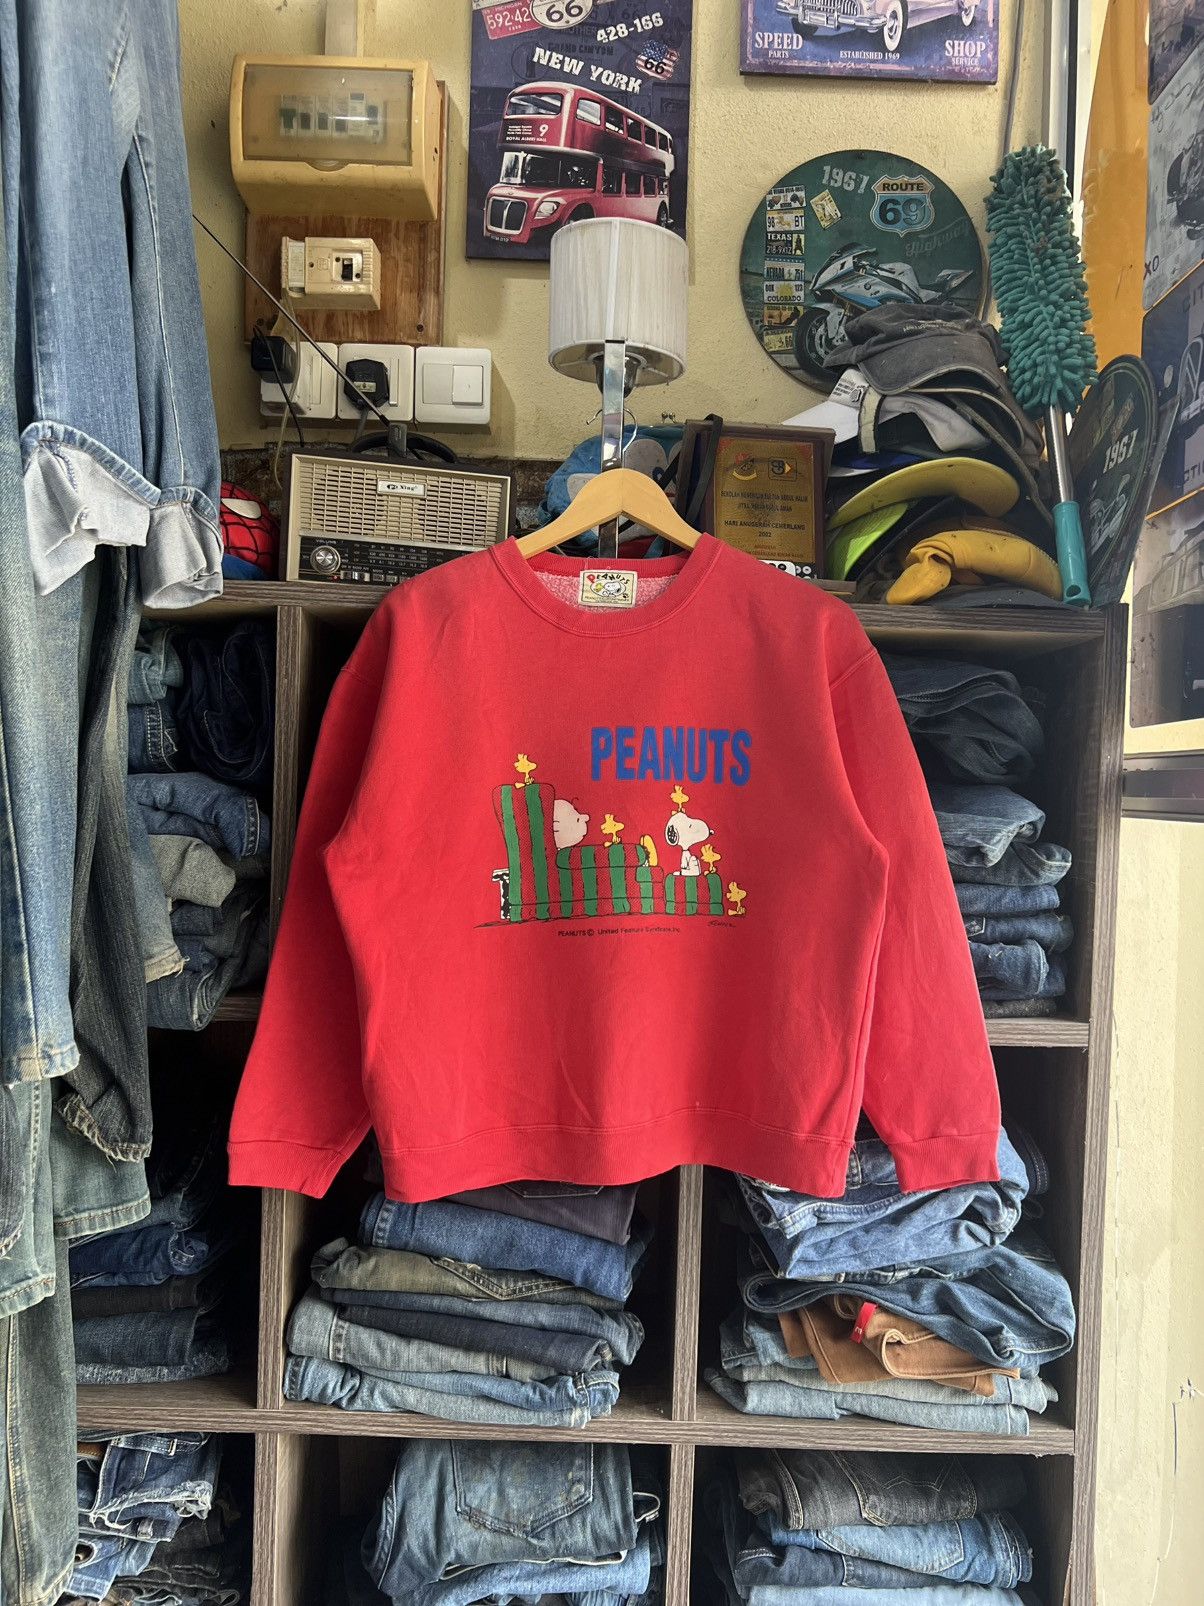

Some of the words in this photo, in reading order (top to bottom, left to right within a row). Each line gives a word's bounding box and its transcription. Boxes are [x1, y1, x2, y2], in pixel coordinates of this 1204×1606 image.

[545, 0, 584, 23] 66
[596, 12, 664, 43] 428-166
[754, 31, 804, 50] SPEED
[945, 39, 986, 57] SHOP
[768, 50, 790, 59] PARTS
[839, 50, 883, 60] ESTABLISHED
[884, 52, 901, 60] 1969
[951, 57, 980, 66] SERVICE
[532, 47, 584, 76] NEW
[589, 64, 643, 94] YORK
[643, 58, 667, 75] 66
[539, 124, 549, 137] 9
[821, 165, 870, 195] 1967
[882, 182, 924, 192] ROUTE
[878, 198, 926, 226] 69
[767, 233, 793, 241] TEXAS
[767, 295, 802, 303] COLORADO
[1102, 428, 1139, 474] 1967
[586, 573, 631, 585] PEANUTS
[590, 726, 753, 787] PEANUTS
